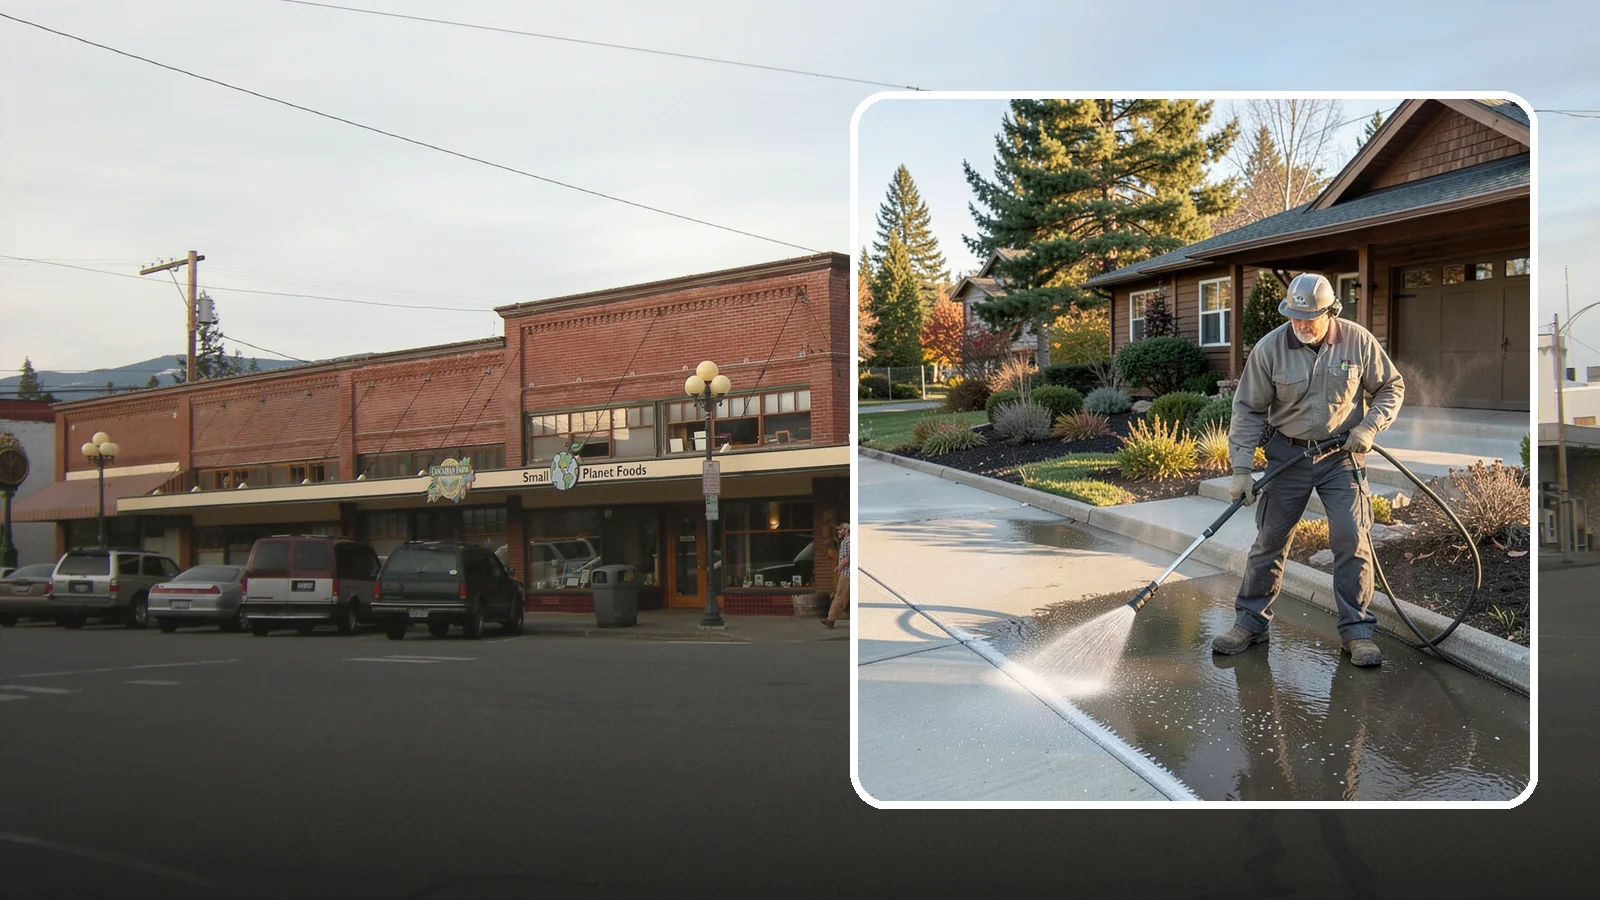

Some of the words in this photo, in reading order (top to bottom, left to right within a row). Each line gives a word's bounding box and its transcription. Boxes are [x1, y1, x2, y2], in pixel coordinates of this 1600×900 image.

[523, 471, 549, 483] Small
[583, 467, 614, 479] Planet
[617, 464, 647, 476] Foods
